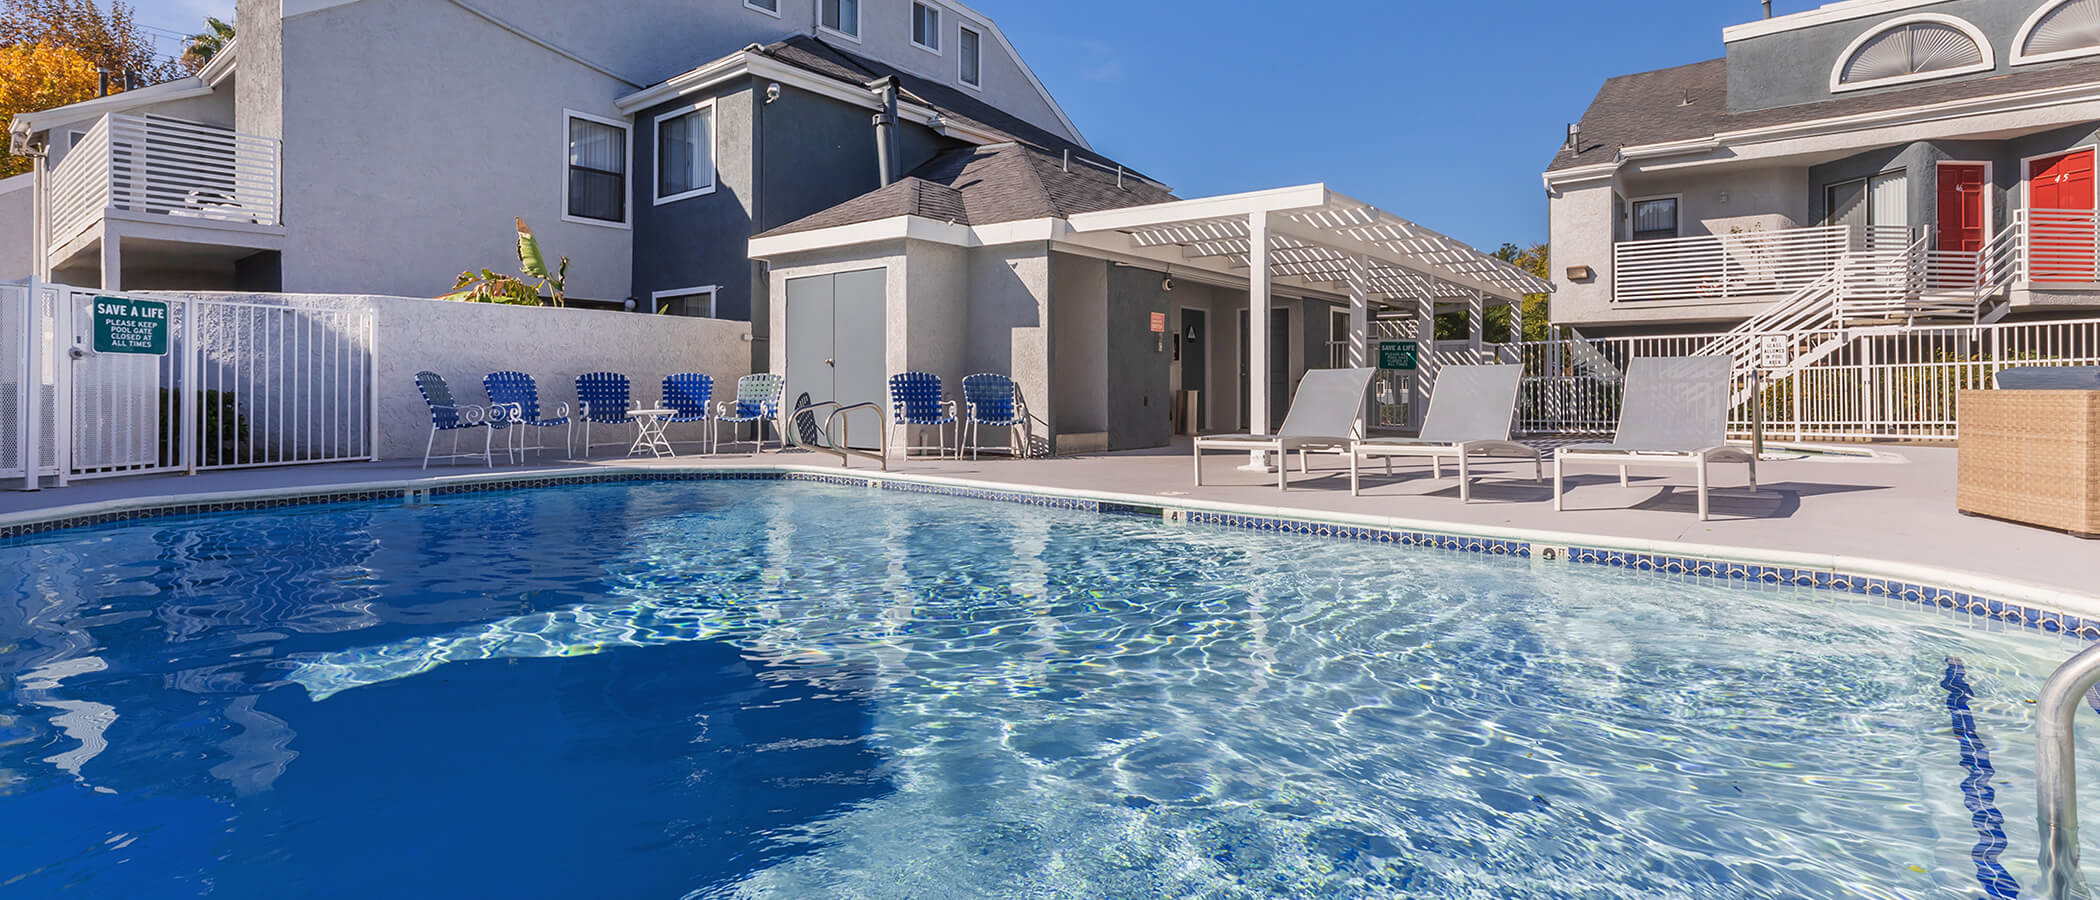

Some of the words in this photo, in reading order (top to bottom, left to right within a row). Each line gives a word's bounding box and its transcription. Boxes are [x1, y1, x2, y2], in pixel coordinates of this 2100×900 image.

[2055, 172, 2069, 183] 45
[97, 303, 128, 316] SAVE
[130, 305, 139, 317] A
[141, 306, 165, 319] LIFE
[105, 318, 136, 327] PLEASE
[137, 321, 158, 329] KEEP
[110, 325, 132, 334] POOL
[133, 327, 153, 335] GATE
[110, 332, 141, 341] CLOSED
[111, 339, 127, 347] ALL
[129, 340, 152, 348] TIMES
